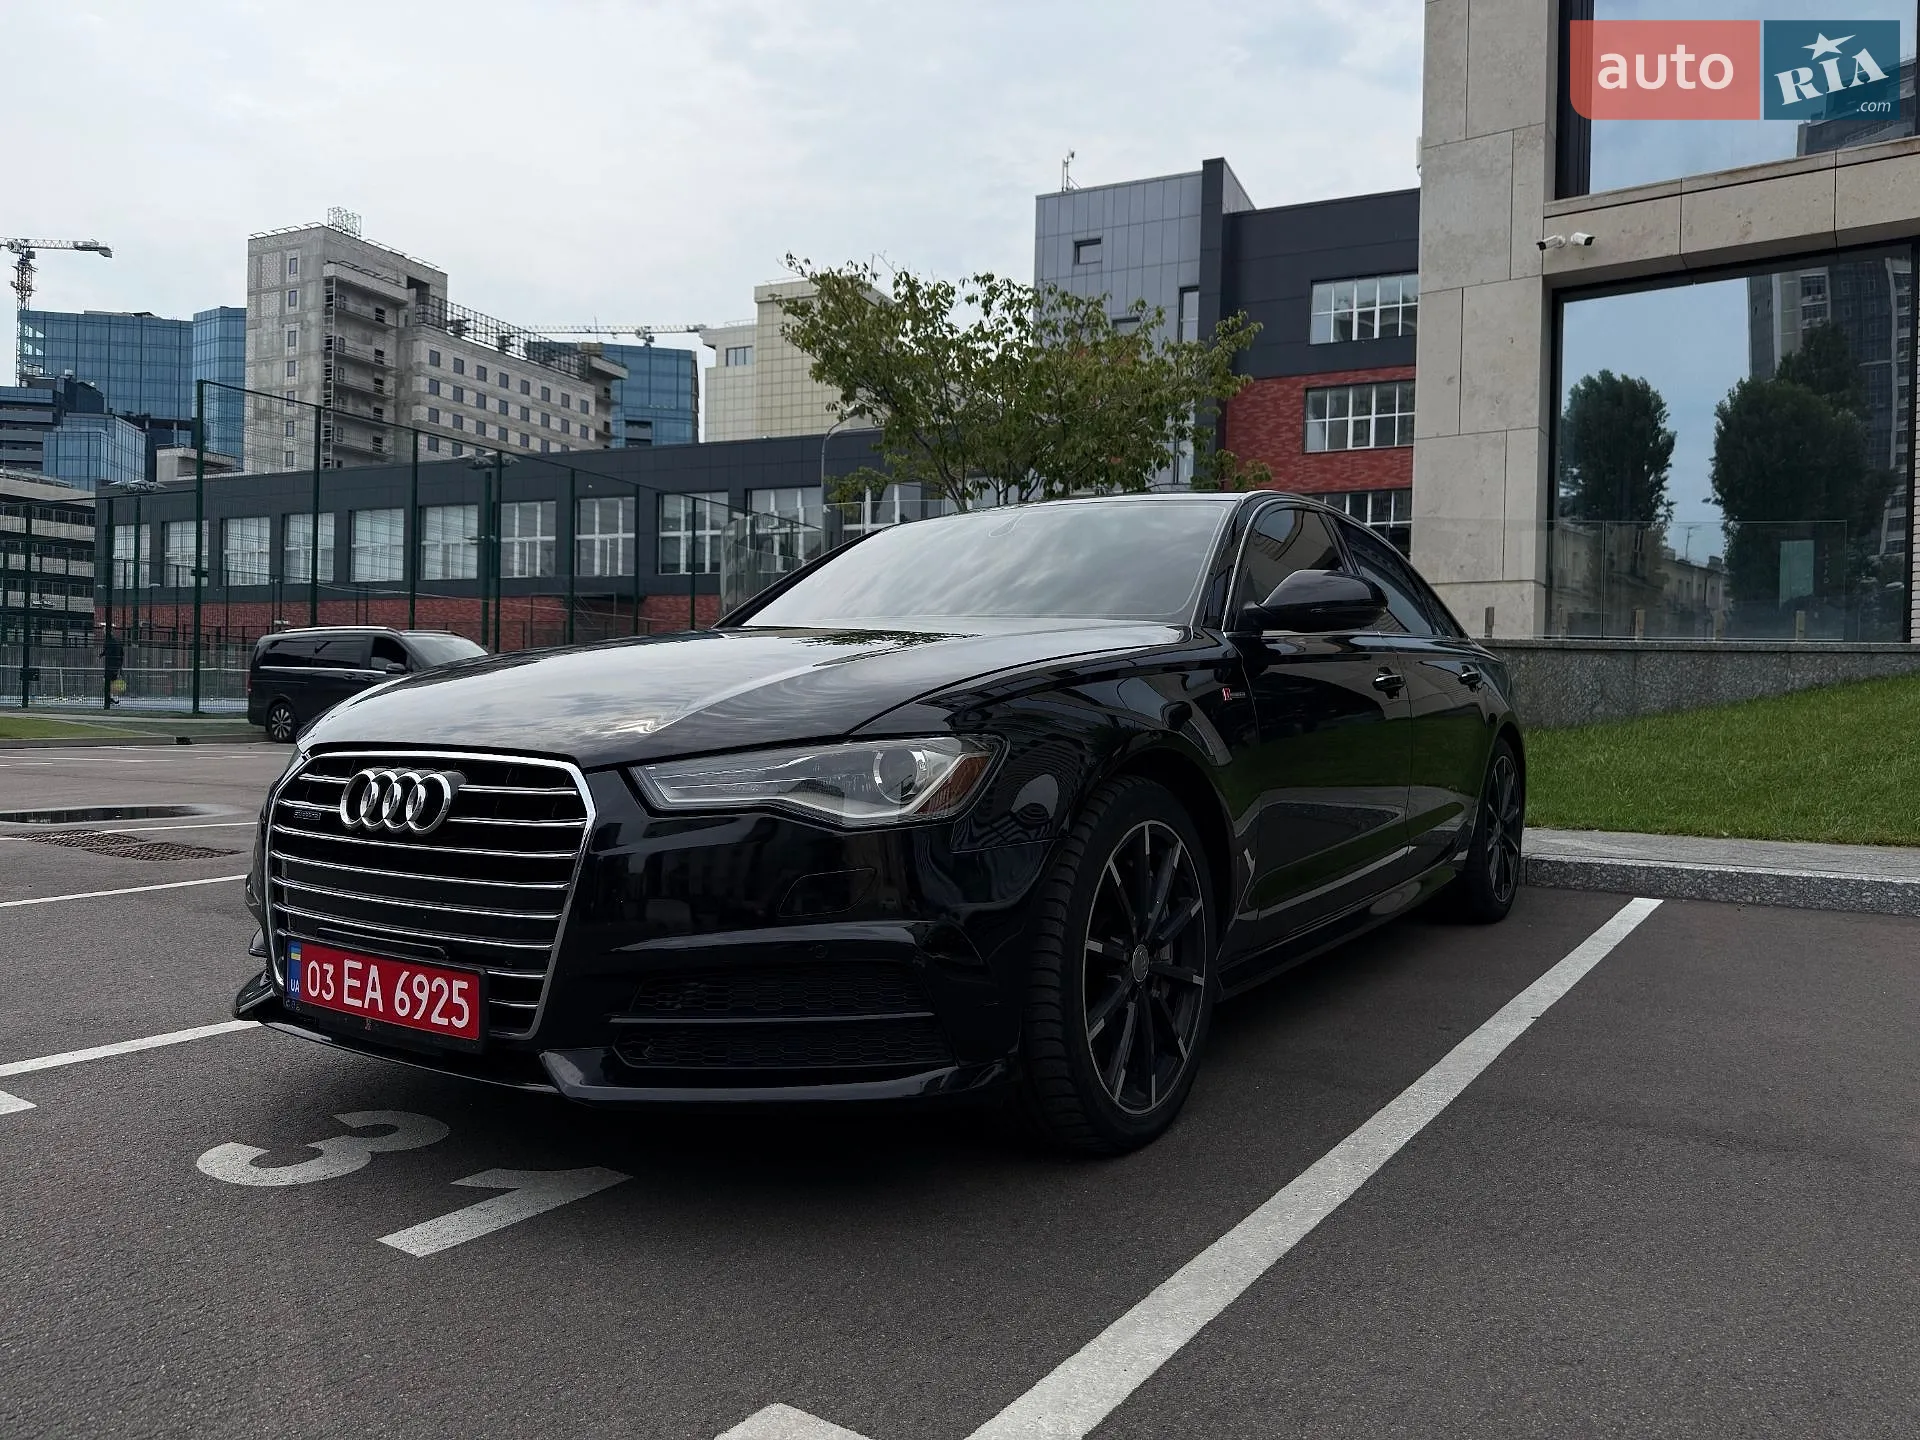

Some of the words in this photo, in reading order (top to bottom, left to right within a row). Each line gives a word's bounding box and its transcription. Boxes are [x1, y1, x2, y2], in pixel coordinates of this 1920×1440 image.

[290, 978, 300, 993] UA
[307, 960, 335, 1001] 03
[343, 959, 384, 1013] EA
[394, 971, 470, 1029] 6925
